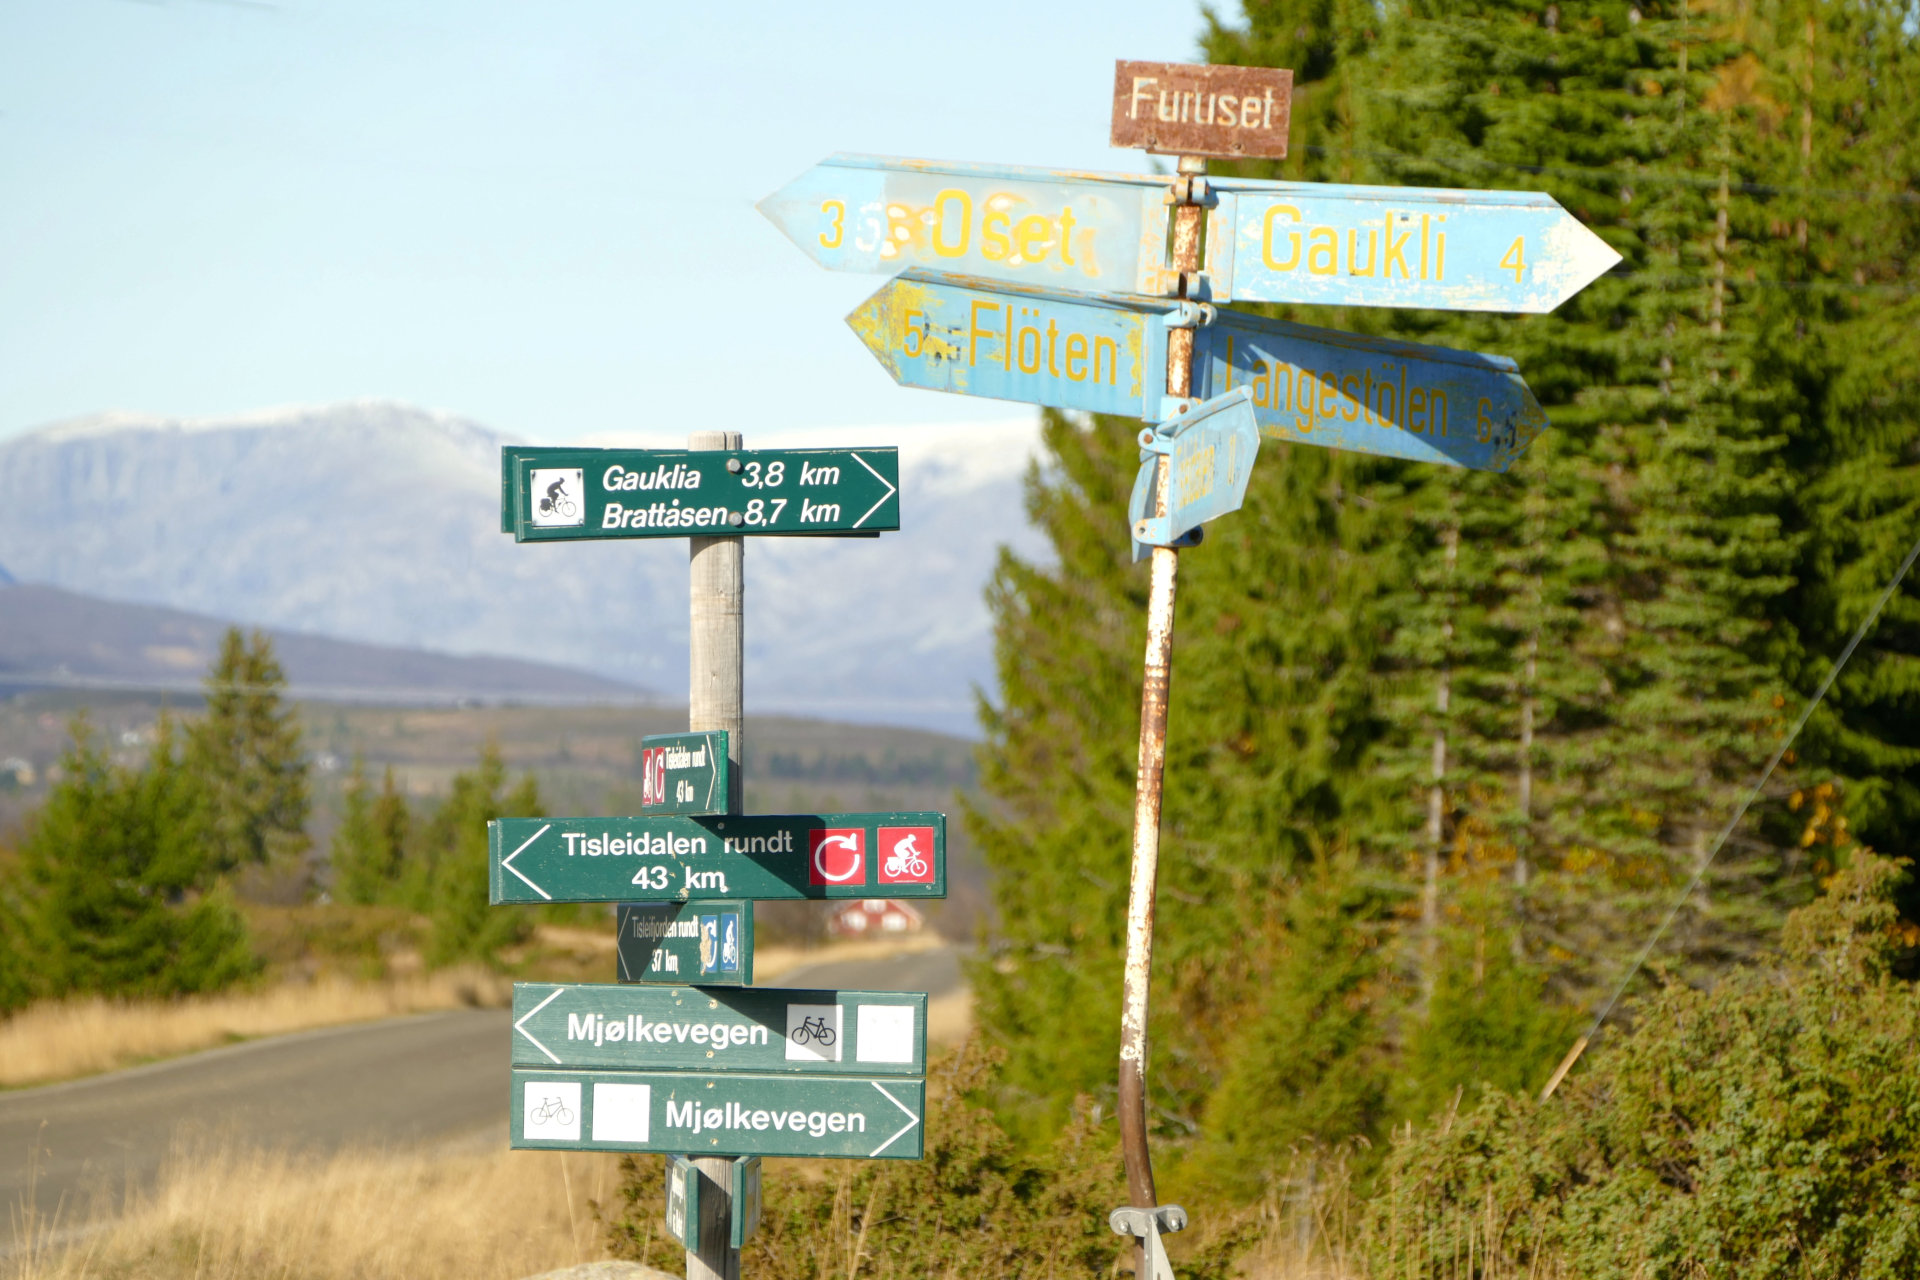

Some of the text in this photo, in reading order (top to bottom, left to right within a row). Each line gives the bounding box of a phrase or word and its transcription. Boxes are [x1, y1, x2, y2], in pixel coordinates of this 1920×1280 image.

[1131, 76, 1274, 129] Furuset
[931, 188, 1077, 266] Oset
[1261, 203, 1527, 283] Gaukli 4
[968, 299, 1117, 385] Flöten
[602, 461, 840, 491] Gauklia 3,8 km
[602, 497, 841, 530] Brattåsen 8,7 km
[676, 779, 694, 804] 43 km
[562, 829, 793, 857] Tisleidalen rundt
[631, 865, 726, 890] 43 km
[631, 914, 699, 942] Tisleifjorden rundt
[651, 948, 679, 972] 37 km
[567, 1012, 768, 1049] Mjølkevegen
[665, 1100, 866, 1137] Mjølkevegen
